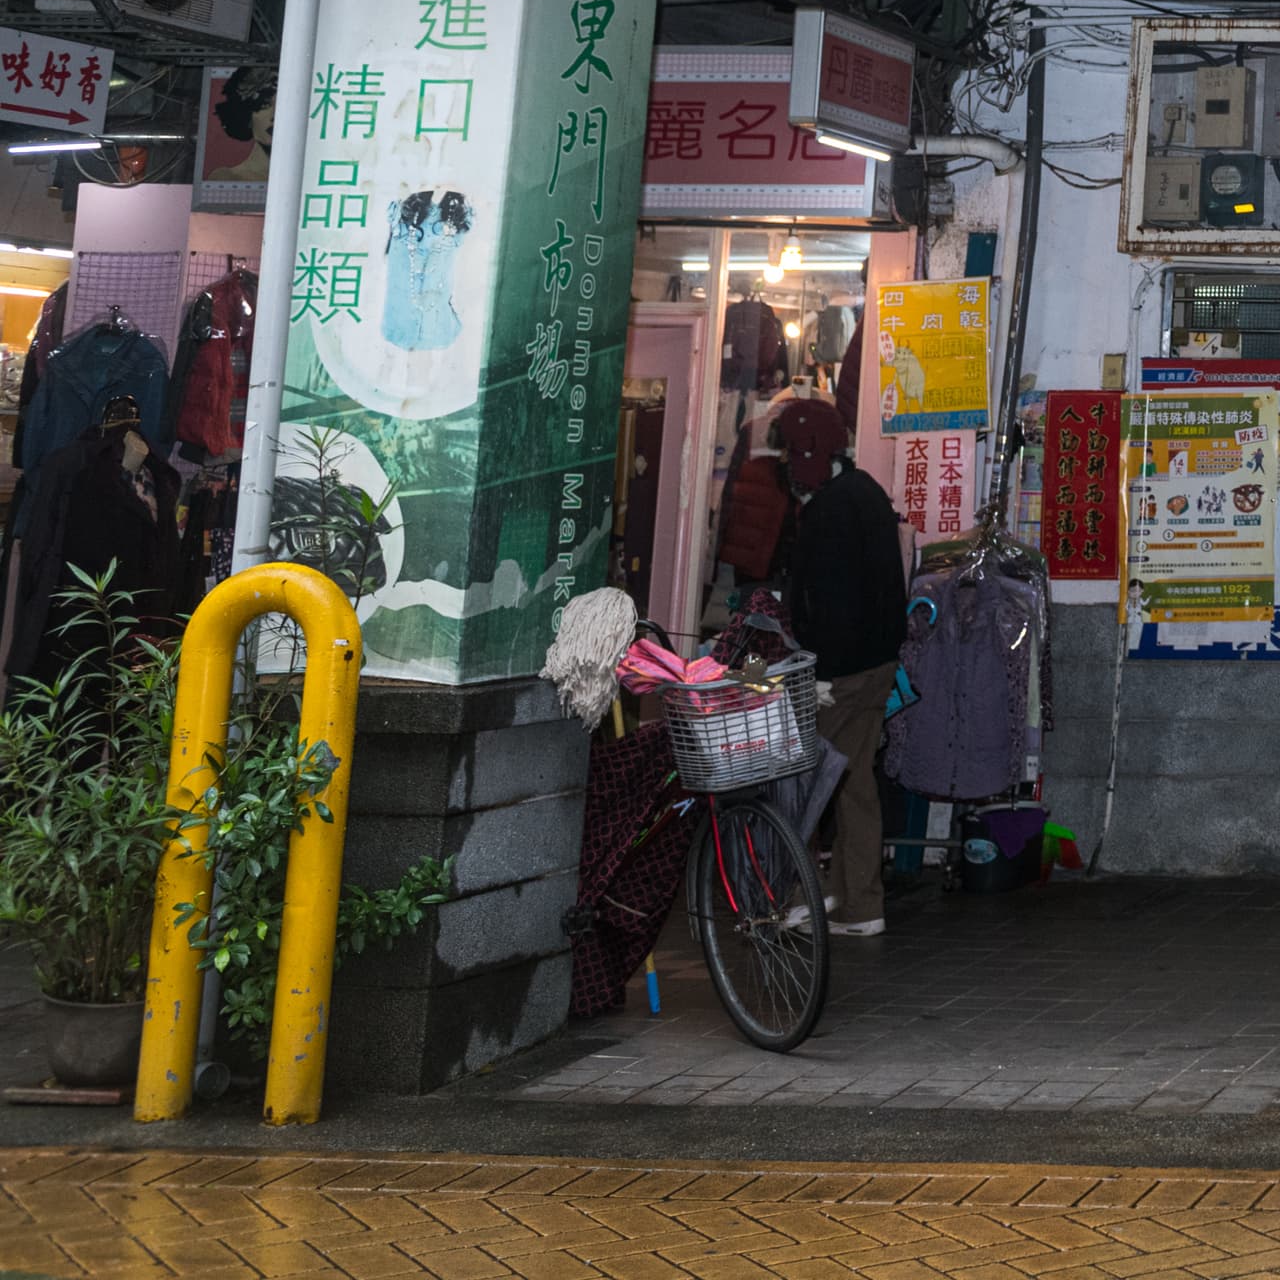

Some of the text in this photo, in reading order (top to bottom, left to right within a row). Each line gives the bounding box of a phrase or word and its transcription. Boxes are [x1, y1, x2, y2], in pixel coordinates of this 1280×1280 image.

[289, 62, 386, 324] 精品類
[552, 235, 603, 632] Donmen Marke
[938, 437, 963, 533] 日本精品
[1223, 584, 1251, 594] 1922
